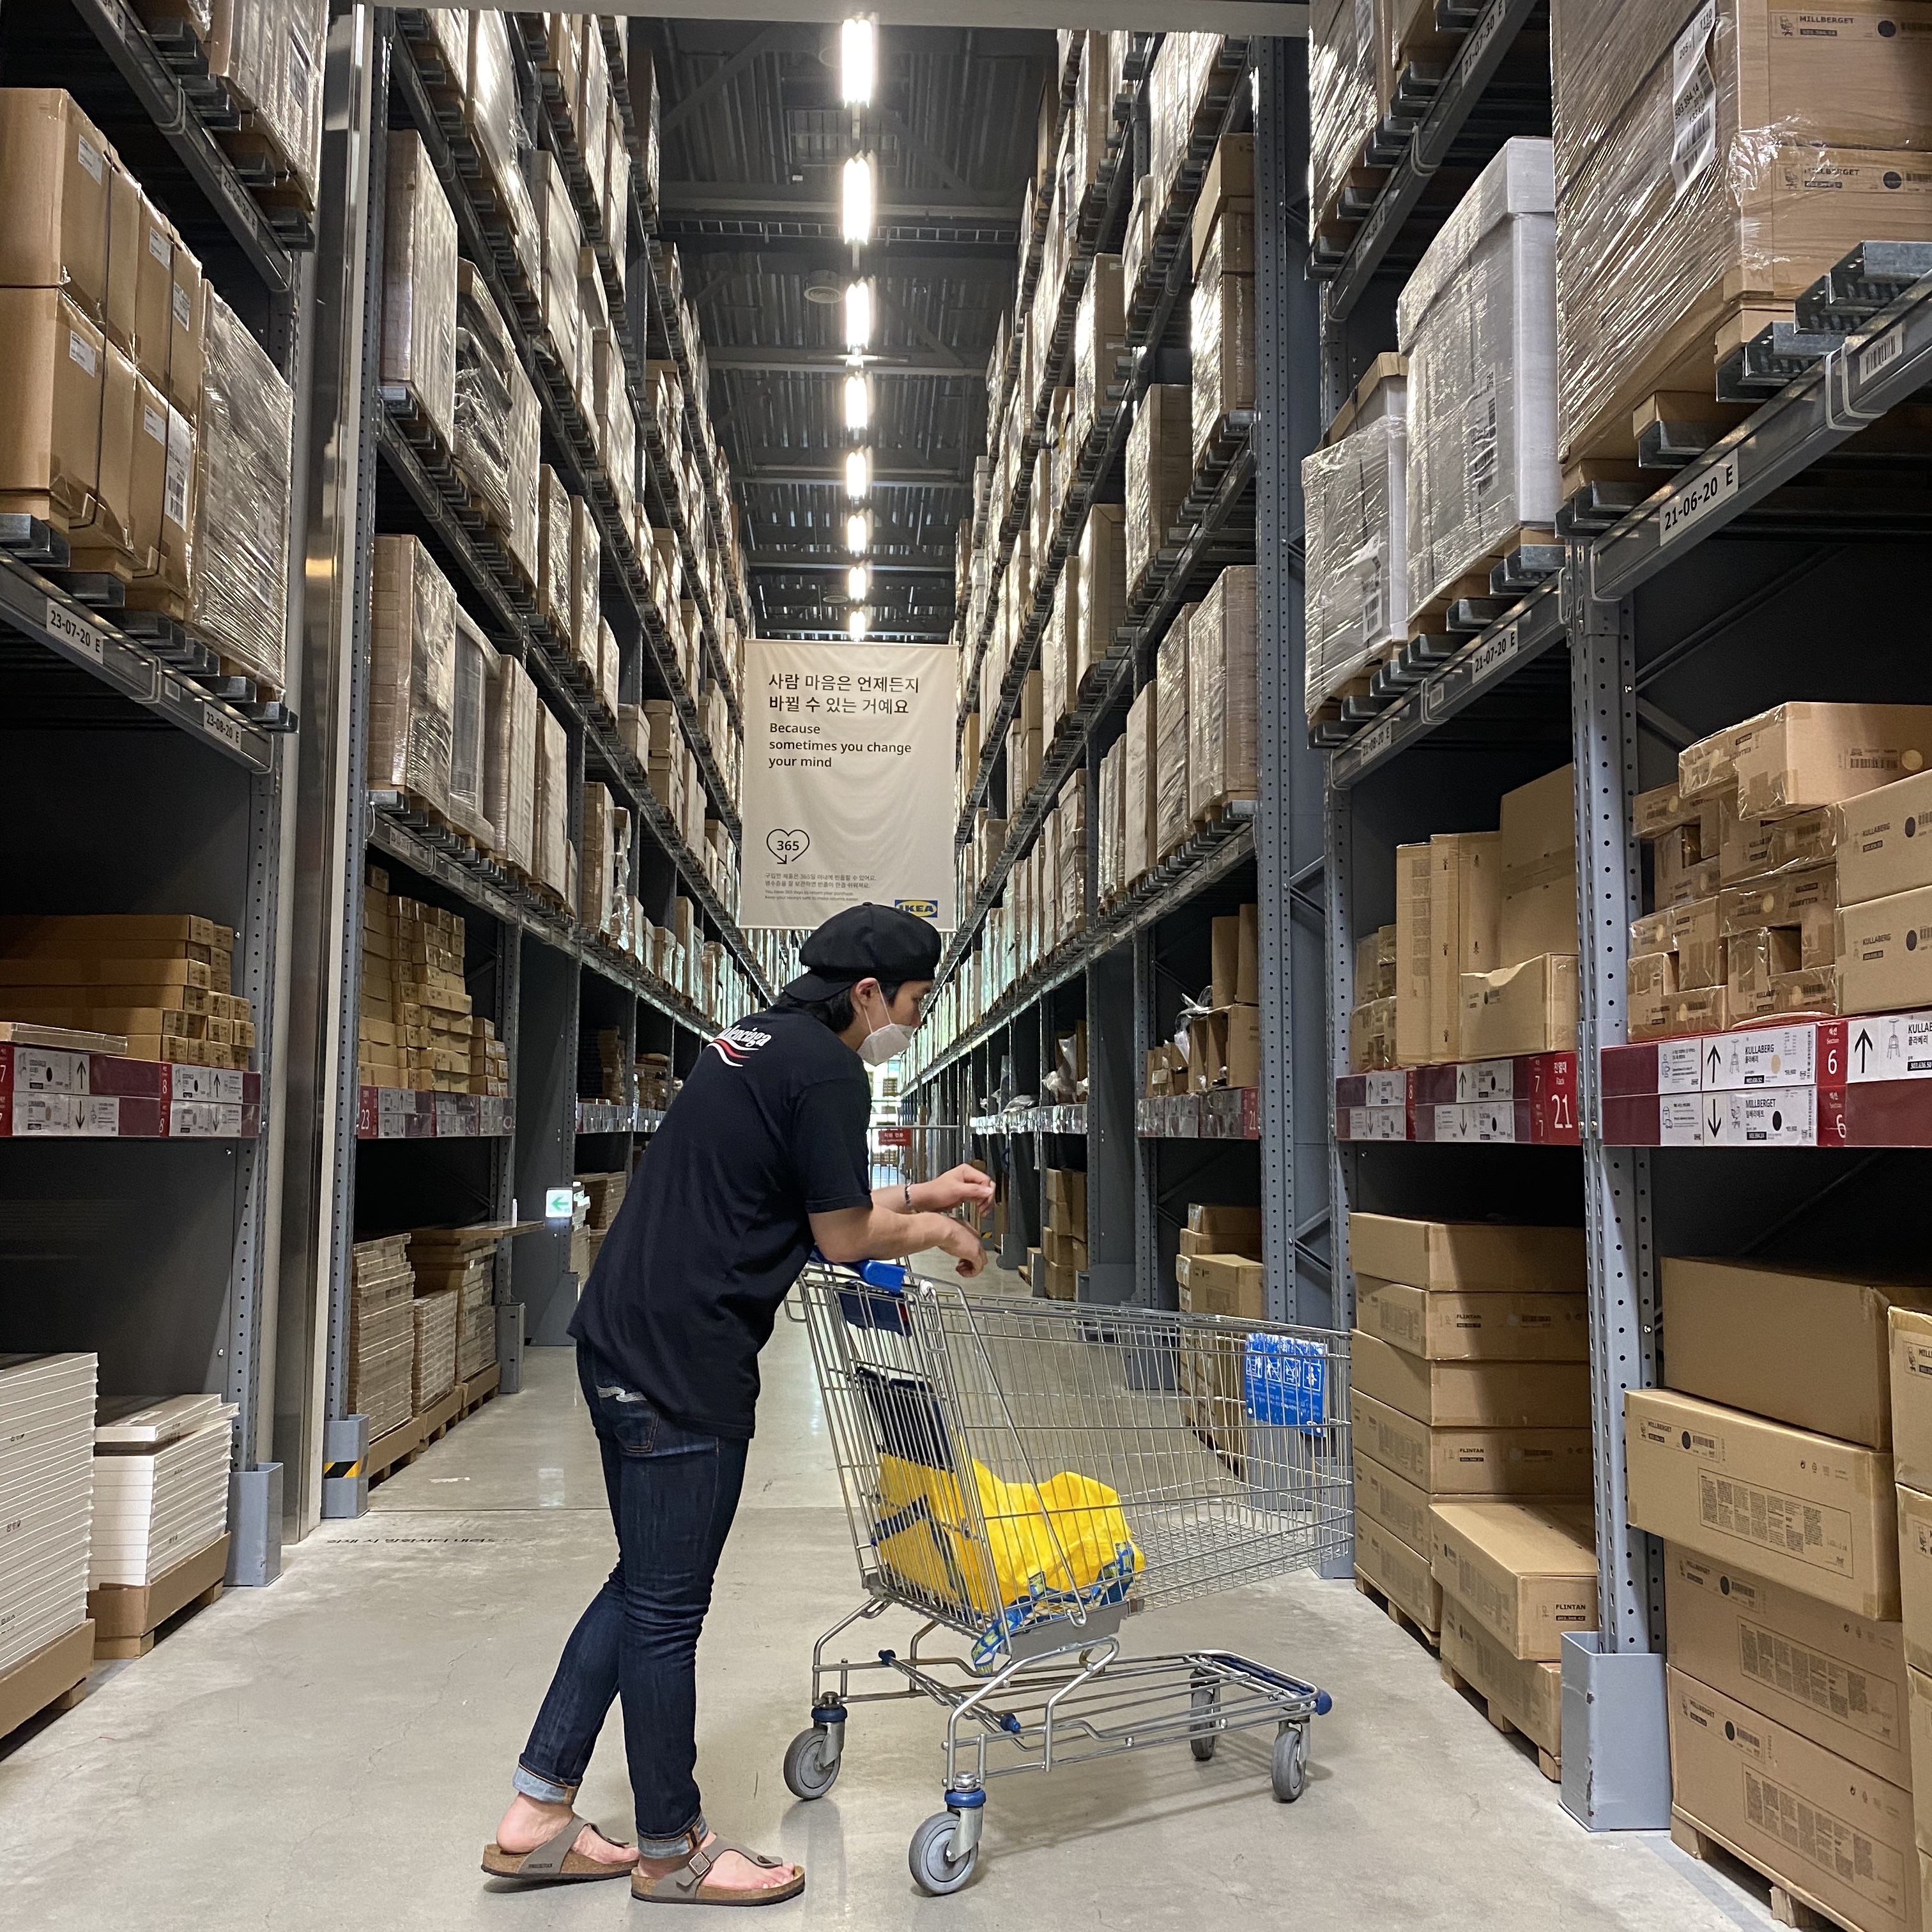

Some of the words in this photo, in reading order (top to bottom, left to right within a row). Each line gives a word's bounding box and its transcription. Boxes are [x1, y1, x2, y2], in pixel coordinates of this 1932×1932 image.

[1799, 15, 1854, 24] MILLBERGET
[1665, 477, 1718, 531] 21-06-20
[1726, 464, 1733, 486] E
[50, 610, 91, 647] 23-07-20
[95, 638, 100, 654] E
[1475, 638, 1506, 673] 21-07-20
[1510, 631, 1515, 647] E
[769, 673, 799, 690] 사람
[805, 675, 852, 691] 마음은
[857, 676, 919, 693] 언제든지
[769, 695, 799, 712] 바뀔
[806, 696, 820, 712] 수
[826, 698, 857, 713] 있는
[862, 698, 909, 714] 거예요
[206, 712, 233, 739] 23-08-20
[235, 732, 240, 744] E
[770, 723, 821, 734] Because
[1386, 726, 1390, 739] E
[769, 740, 838, 751] sometimes
[841, 742, 863, 754] you
[867, 742, 912, 755] change
[769, 757, 797, 769] your
[801, 756, 832, 767] mind
[776, 840, 799, 851] 365
[898, 904, 934, 913] IKEA
[1745, 1043, 1775, 1055] KULLABERG
[1828, 1049, 1837, 1075] 6
[162, 1079, 167, 1094] 8
[1409, 1084, 1413, 1100] 8
[1535, 1075, 1540, 1092] 7
[1551, 1094, 1573, 1129] 21
[1745, 1098, 1776, 1108] MILLBERGET
[361, 1109, 370, 1130] 23
[1538, 1119, 1544, 1137] 7
[1836, 1114, 1847, 1138] 6
